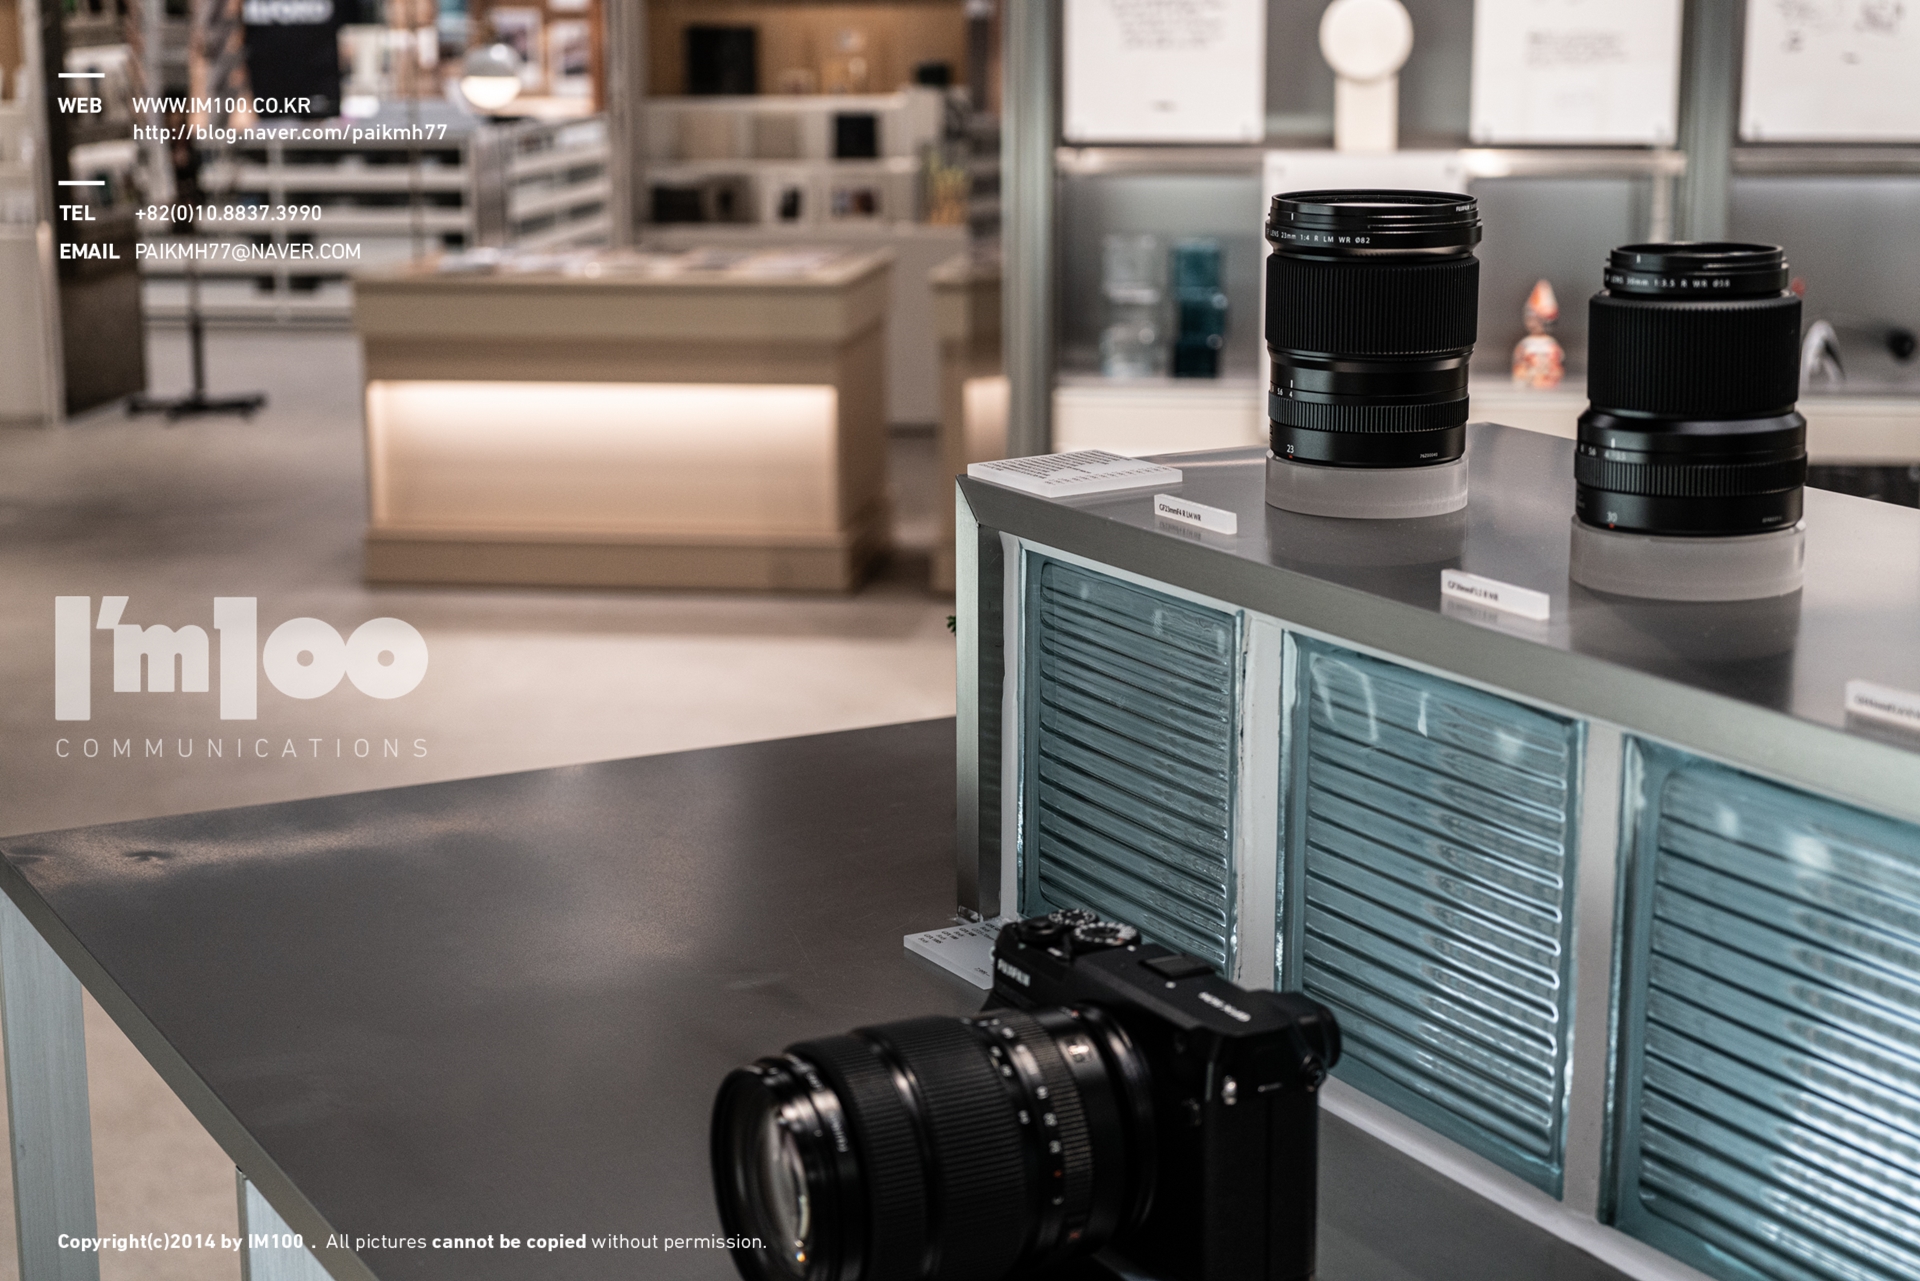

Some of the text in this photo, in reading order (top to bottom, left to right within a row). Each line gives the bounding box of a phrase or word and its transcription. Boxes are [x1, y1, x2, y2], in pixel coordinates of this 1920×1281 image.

[1281, 231, 1296, 240] 23mm
[1338, 236, 1351, 244] WR
[1286, 444, 1295, 454] 23
